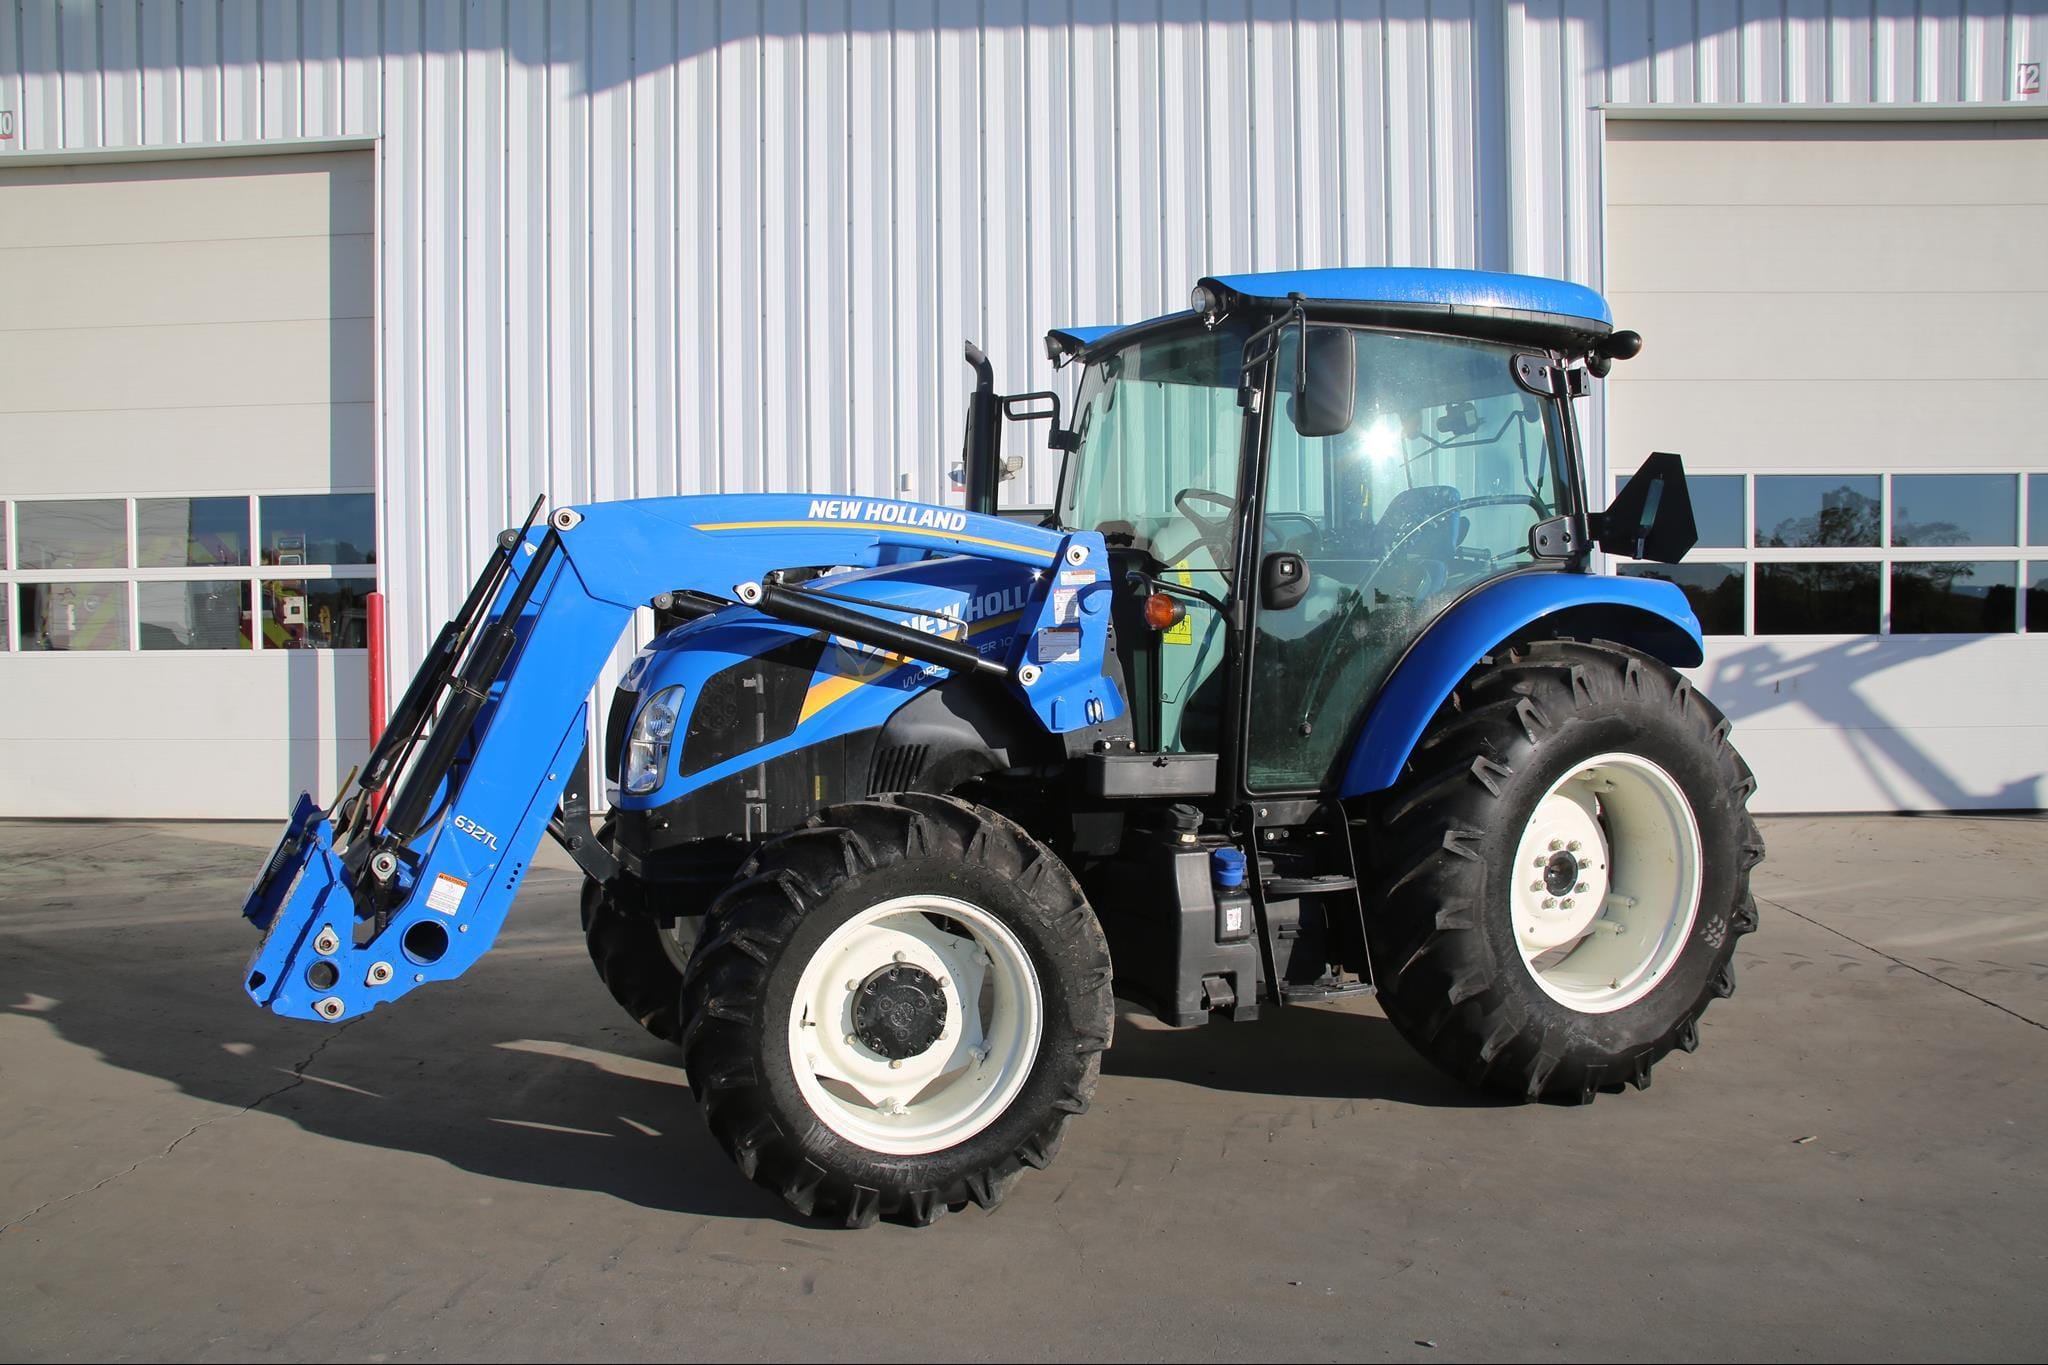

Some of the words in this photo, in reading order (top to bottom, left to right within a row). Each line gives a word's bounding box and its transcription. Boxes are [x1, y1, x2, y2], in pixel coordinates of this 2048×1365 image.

[2017, 65, 2039, 89] 12
[808, 499, 863, 520] NEW
[864, 502, 967, 532] HOLLAND
[454, 814, 498, 851] 632TL
